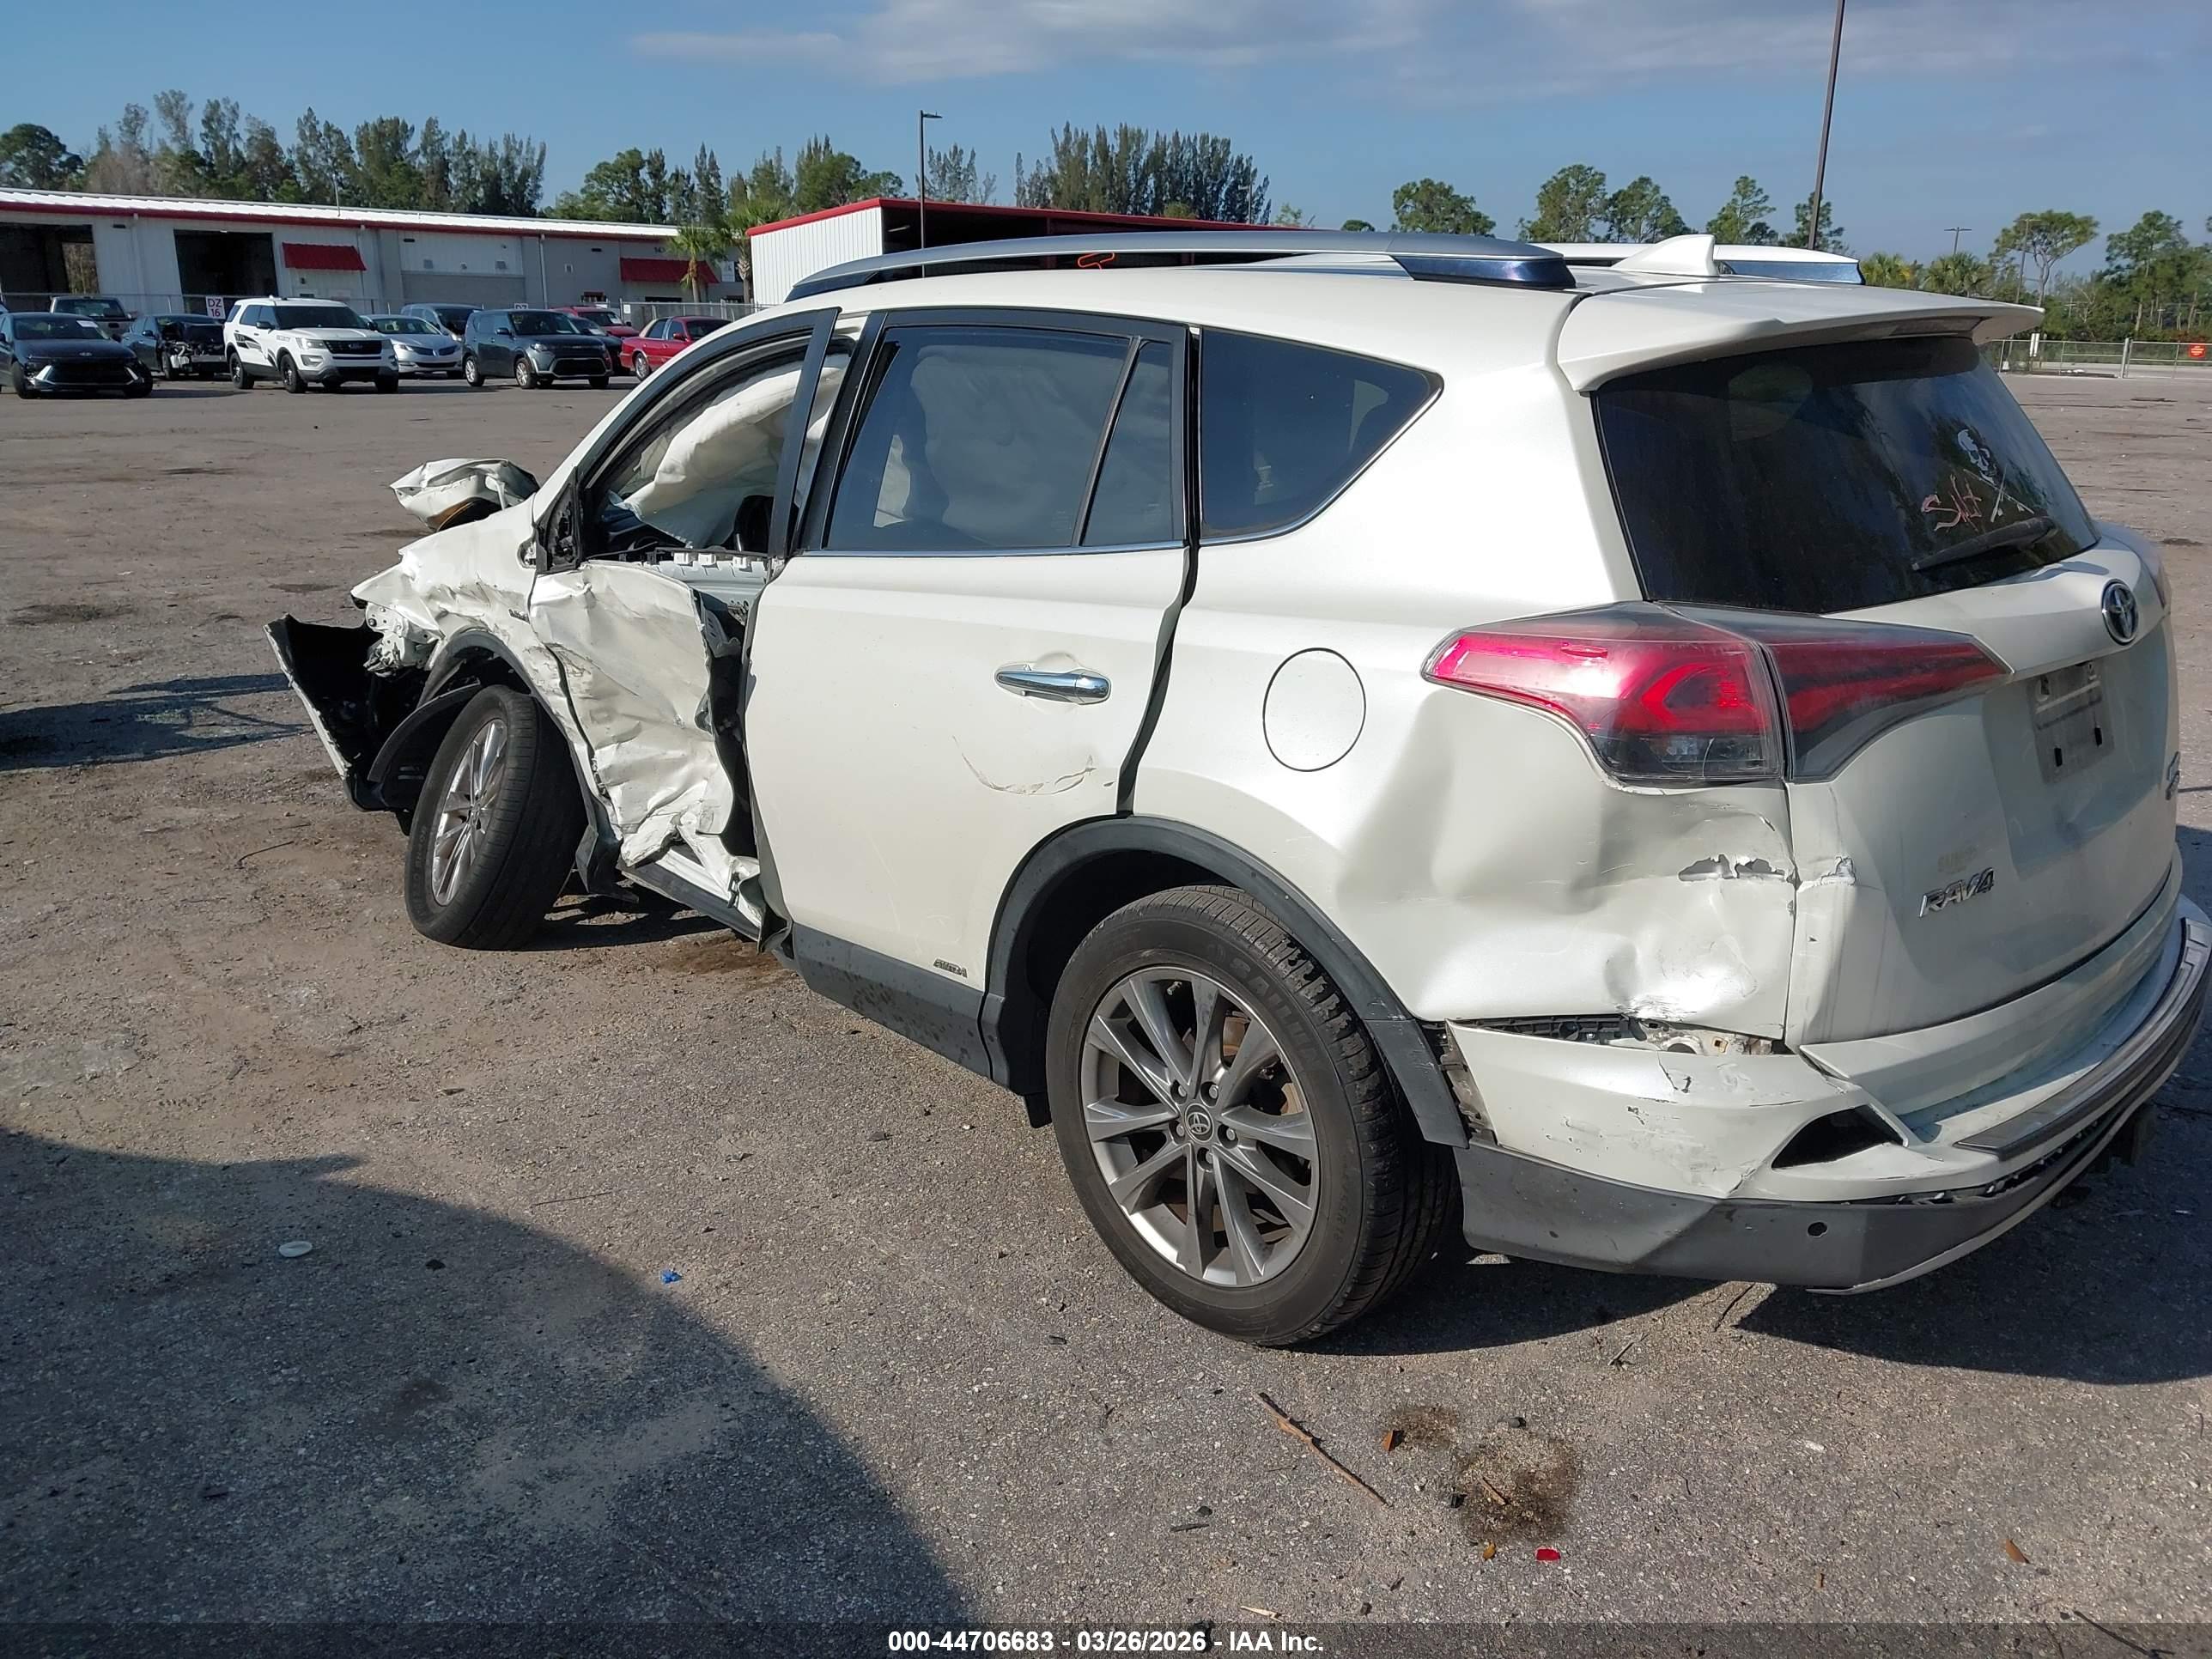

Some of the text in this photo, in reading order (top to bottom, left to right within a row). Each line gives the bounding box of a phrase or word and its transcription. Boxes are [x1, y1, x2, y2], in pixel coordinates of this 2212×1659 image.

[208, 298, 222, 307] DZ
[211, 308, 221, 318] 16
[1918, 866, 1996, 918] RAV4
